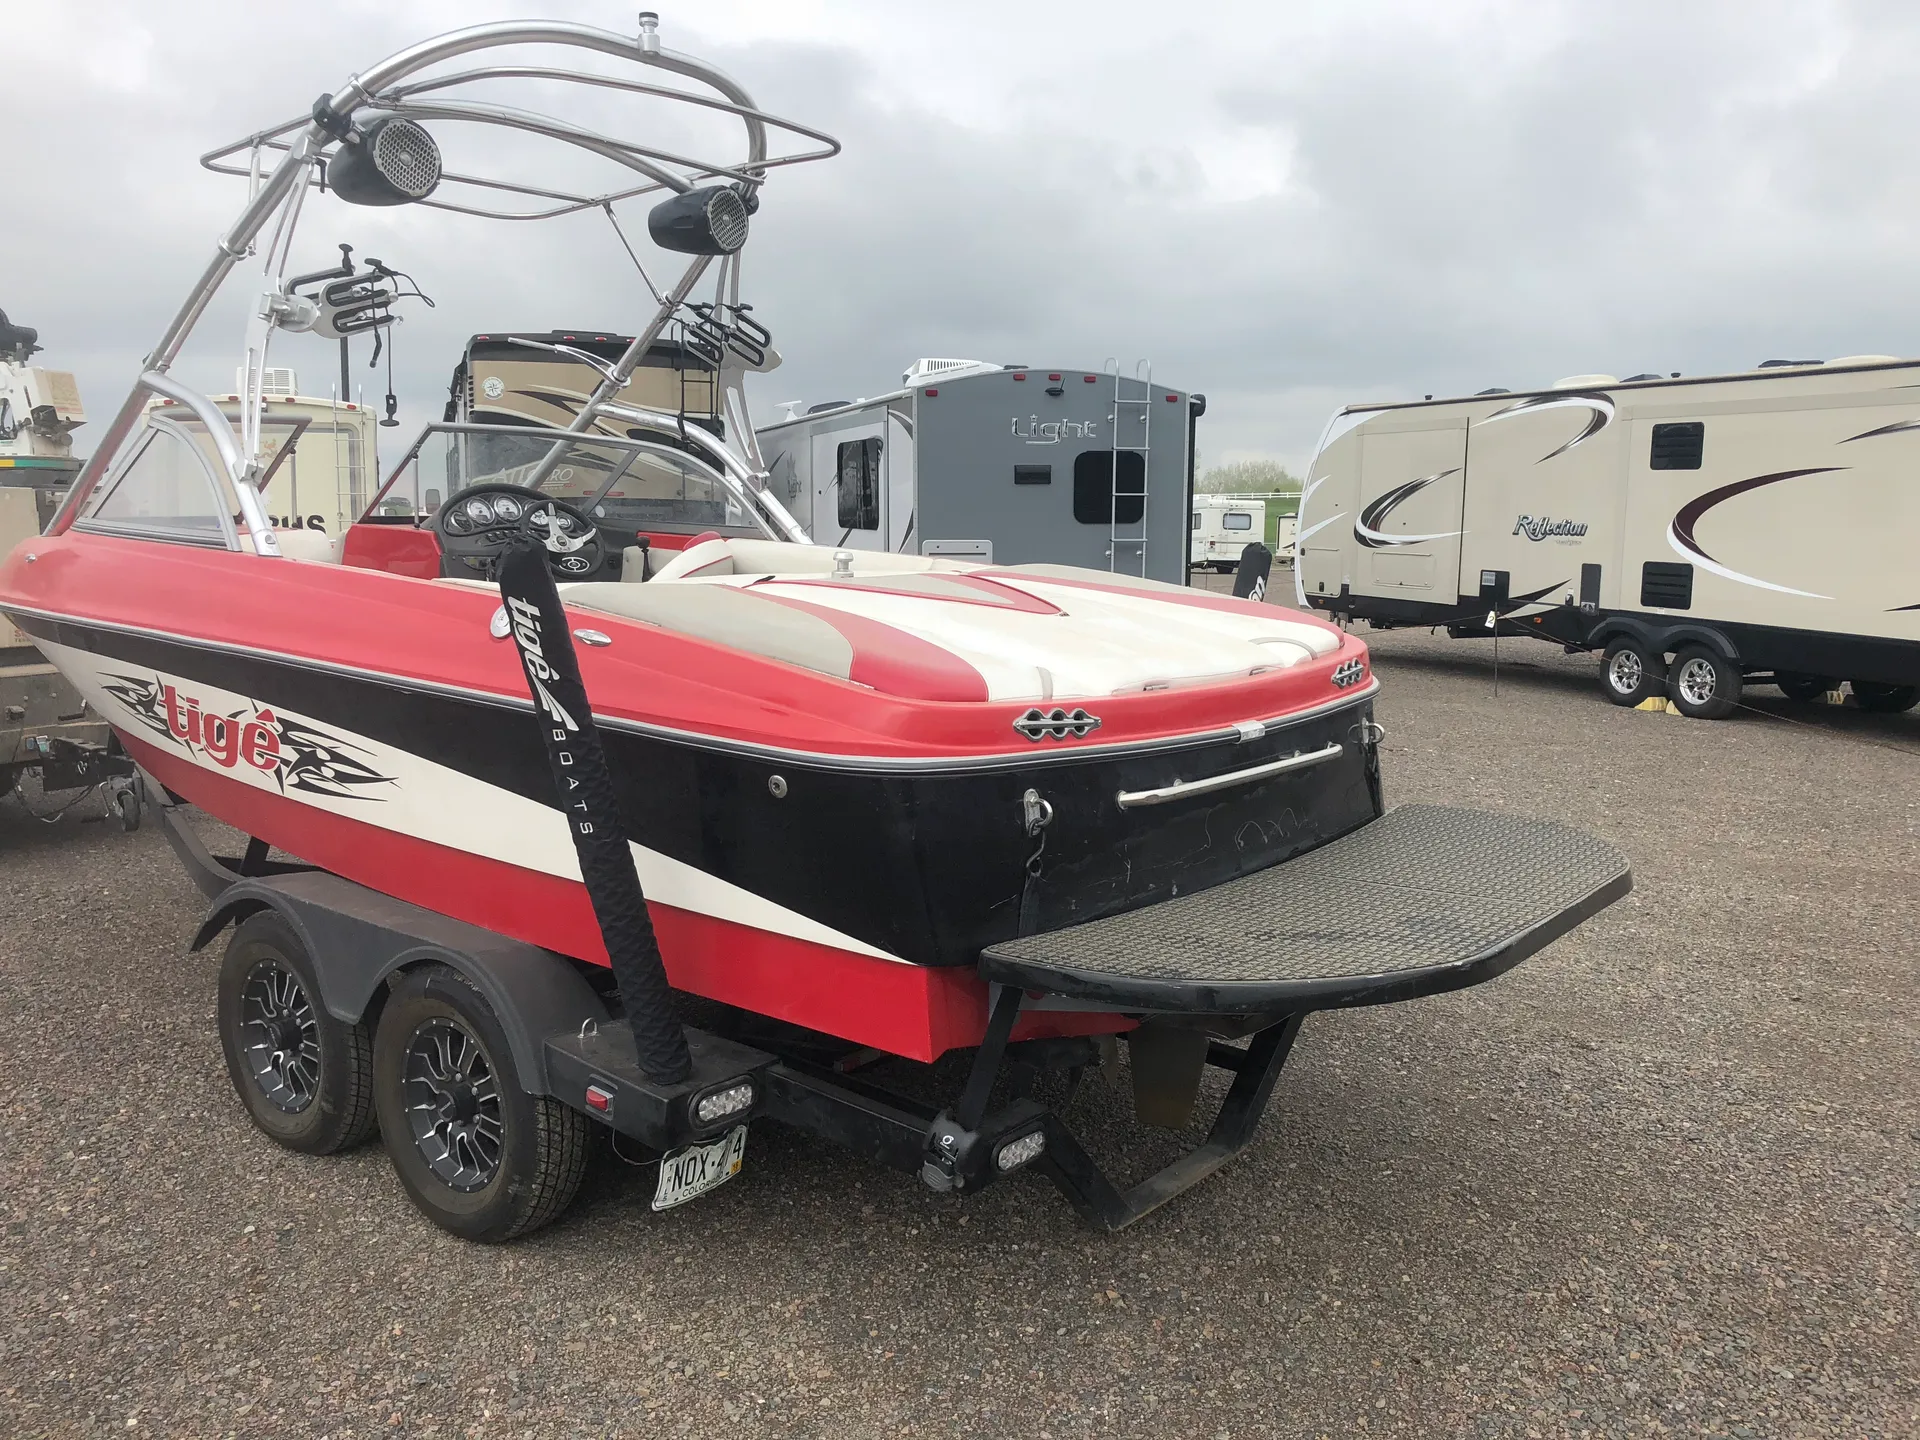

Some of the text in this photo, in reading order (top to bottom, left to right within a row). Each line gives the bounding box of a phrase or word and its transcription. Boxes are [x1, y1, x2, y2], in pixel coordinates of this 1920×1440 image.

[1011, 413, 1097, 445] Light
[1512, 515, 1588, 541] Reflection
[552, 727, 594, 835] BOATS
